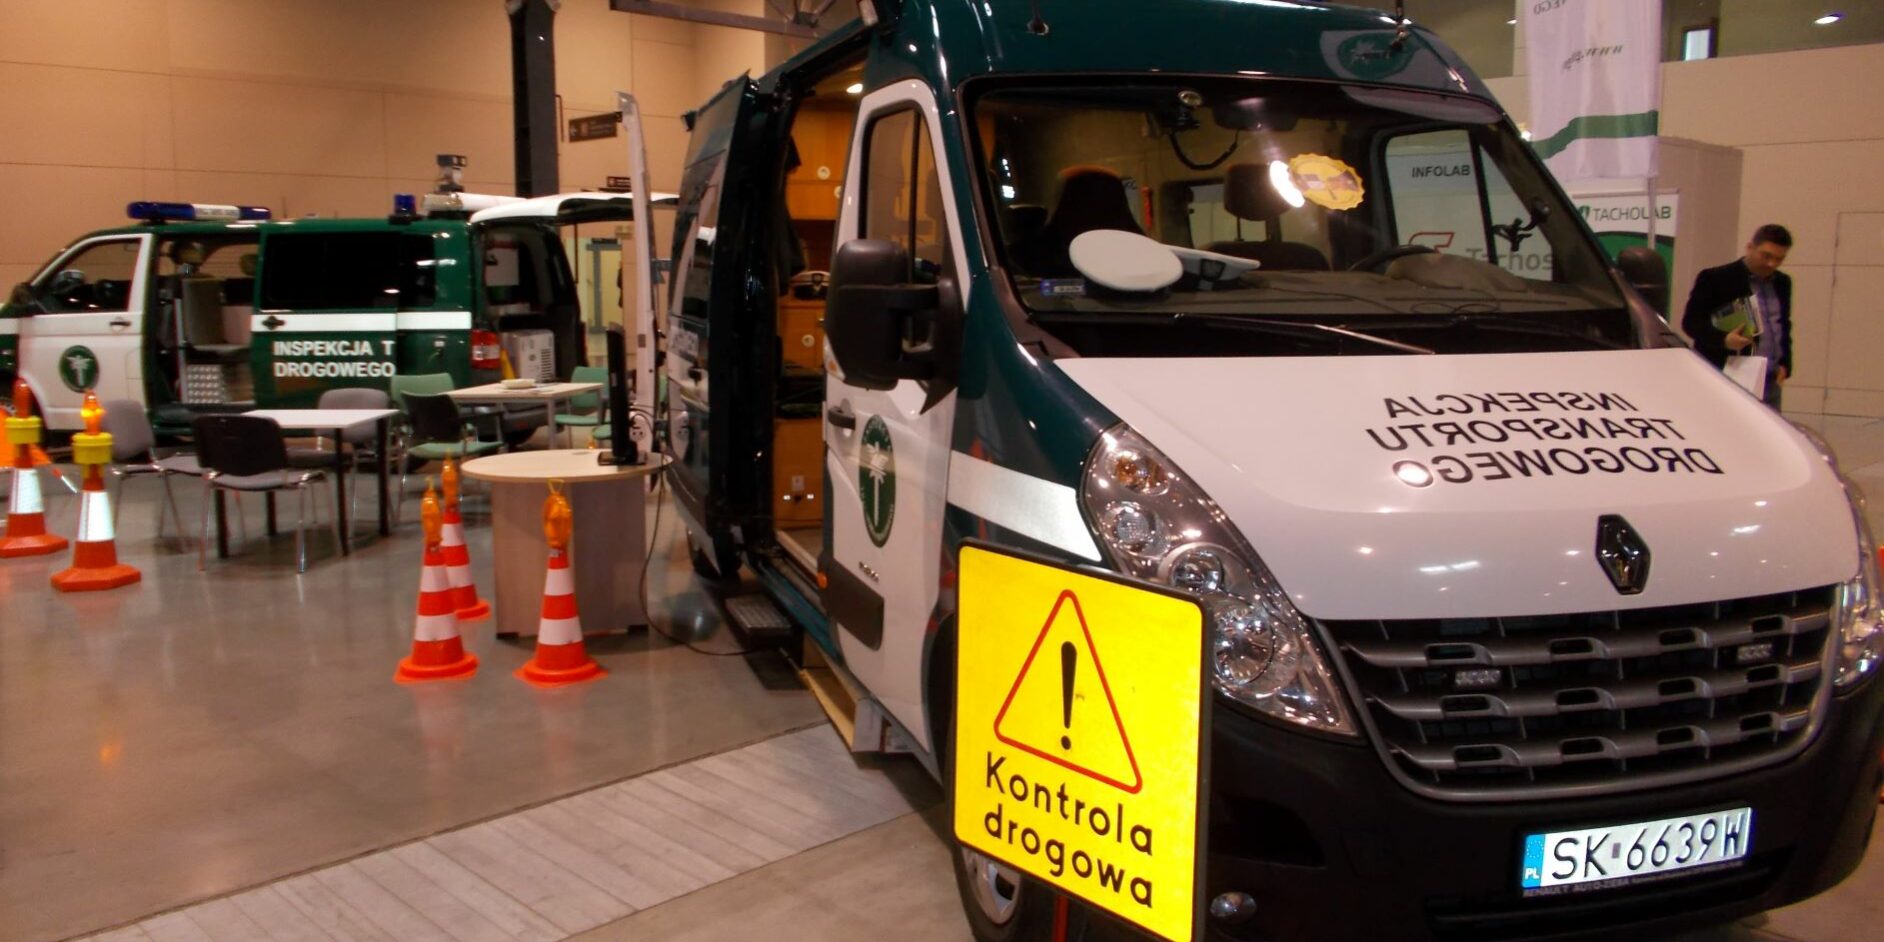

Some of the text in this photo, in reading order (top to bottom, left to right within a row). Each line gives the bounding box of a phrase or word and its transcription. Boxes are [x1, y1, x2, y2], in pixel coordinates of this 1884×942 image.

[1411, 164, 1471, 178] INFOLAB
[273, 340, 374, 356] INSPEKCJA
[273, 361, 396, 378] DROGOWEGO
[986, 750, 1152, 856] Kontrola
[984, 803, 1152, 909] drogowa
[1551, 832, 1612, 880] SK
[1524, 867, 1540, 880] PL
